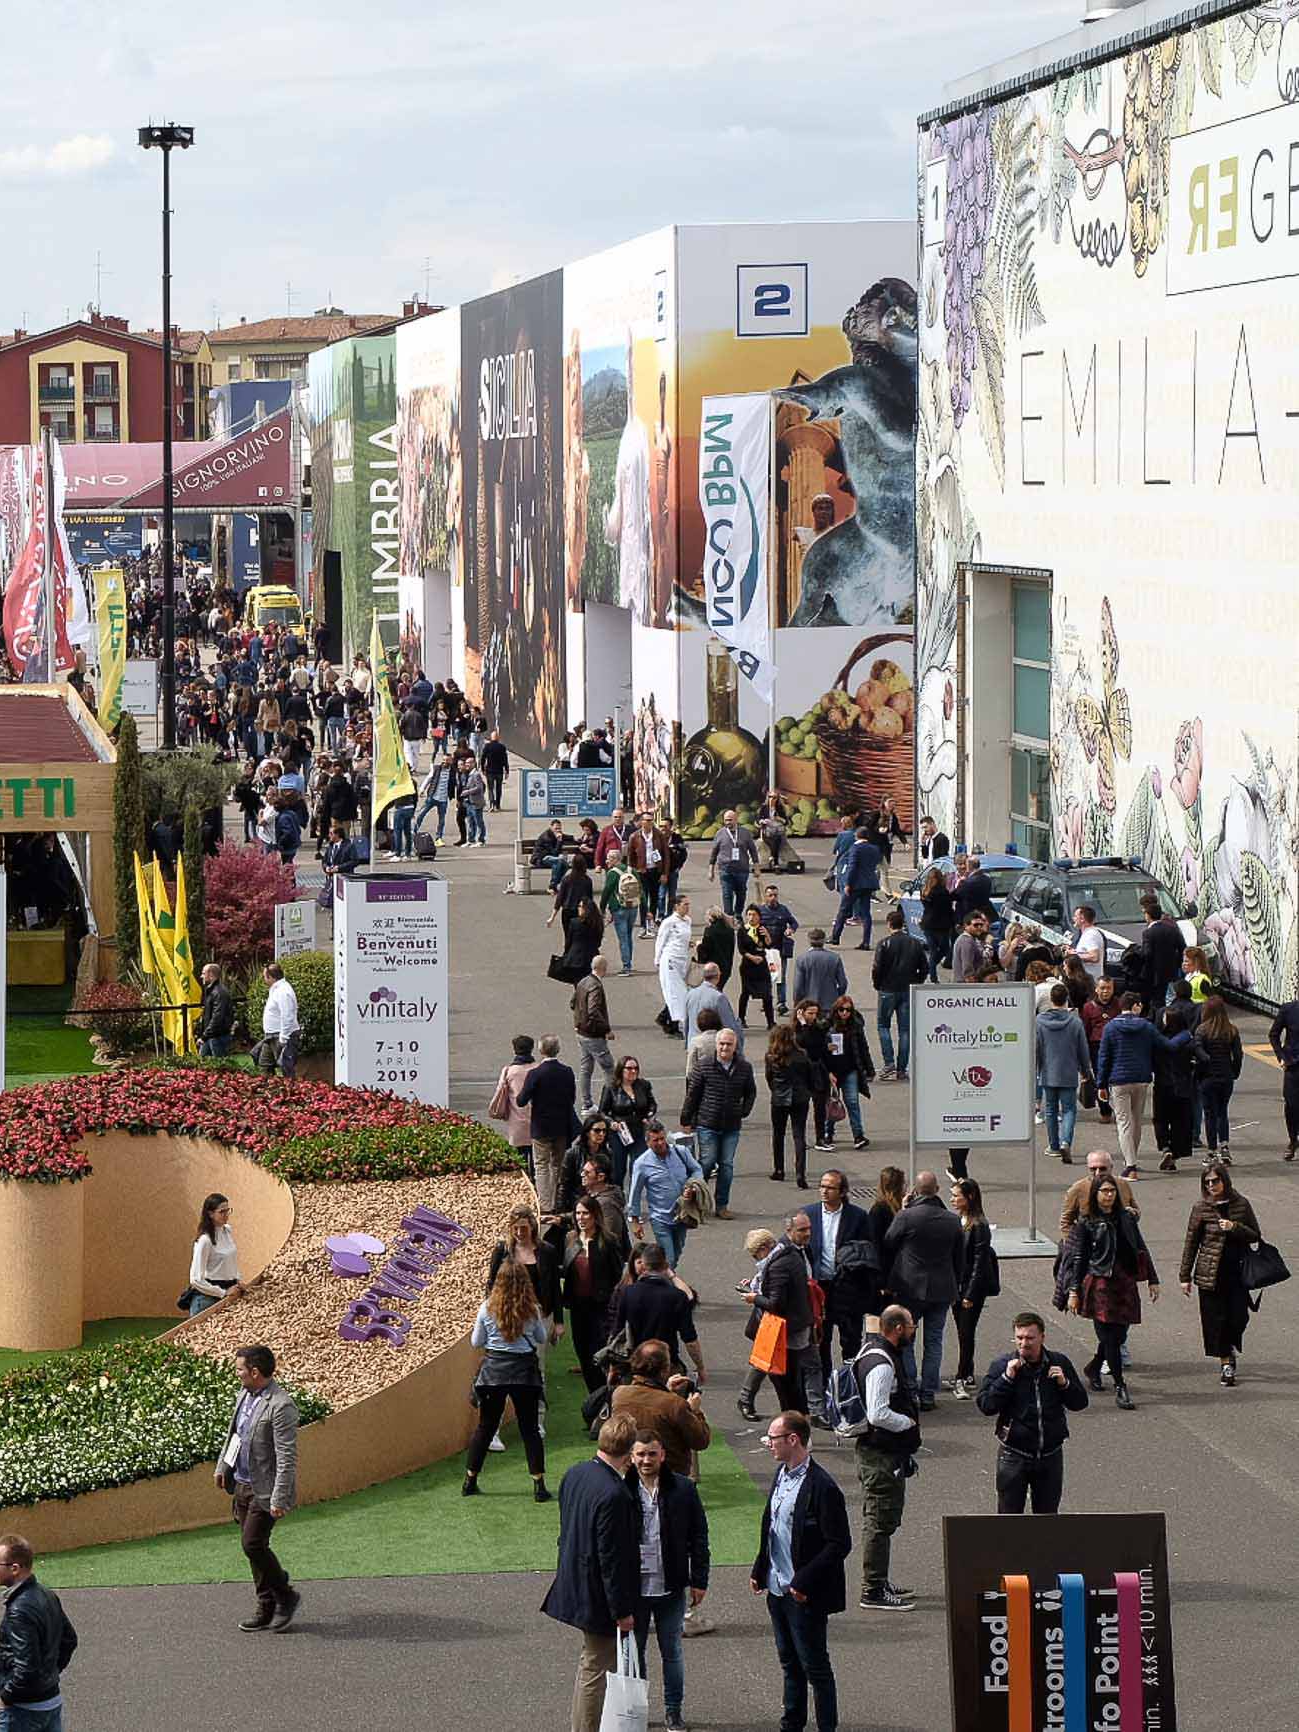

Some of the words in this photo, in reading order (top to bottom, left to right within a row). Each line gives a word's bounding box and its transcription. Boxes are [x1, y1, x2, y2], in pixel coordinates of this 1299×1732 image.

[932, 185, 939, 221] 1
[753, 284, 792, 316] 2
[480, 349, 538, 441] SICILIA
[171, 426, 284, 498] SIGNORVINO
[357, 936, 438, 950] Benvenuti
[384, 954, 438, 966] Welcome
[356, 996, 438, 1022] vinitaly
[927, 997, 984, 1008] ORGANIC
[986, 997, 1018, 1008] HALL
[376, 1041, 419, 1053] 7-10
[375, 1058, 420, 1066] APRIL
[377, 1070, 418, 1082] 2019
[990, 1115, 1002, 1132] F
[370, 1204, 474, 1302] vinitaly
[1139, 1563, 1155, 1604] min.
[980, 1615, 1010, 1692] Food
[1094, 1612, 1121, 1693] Point
